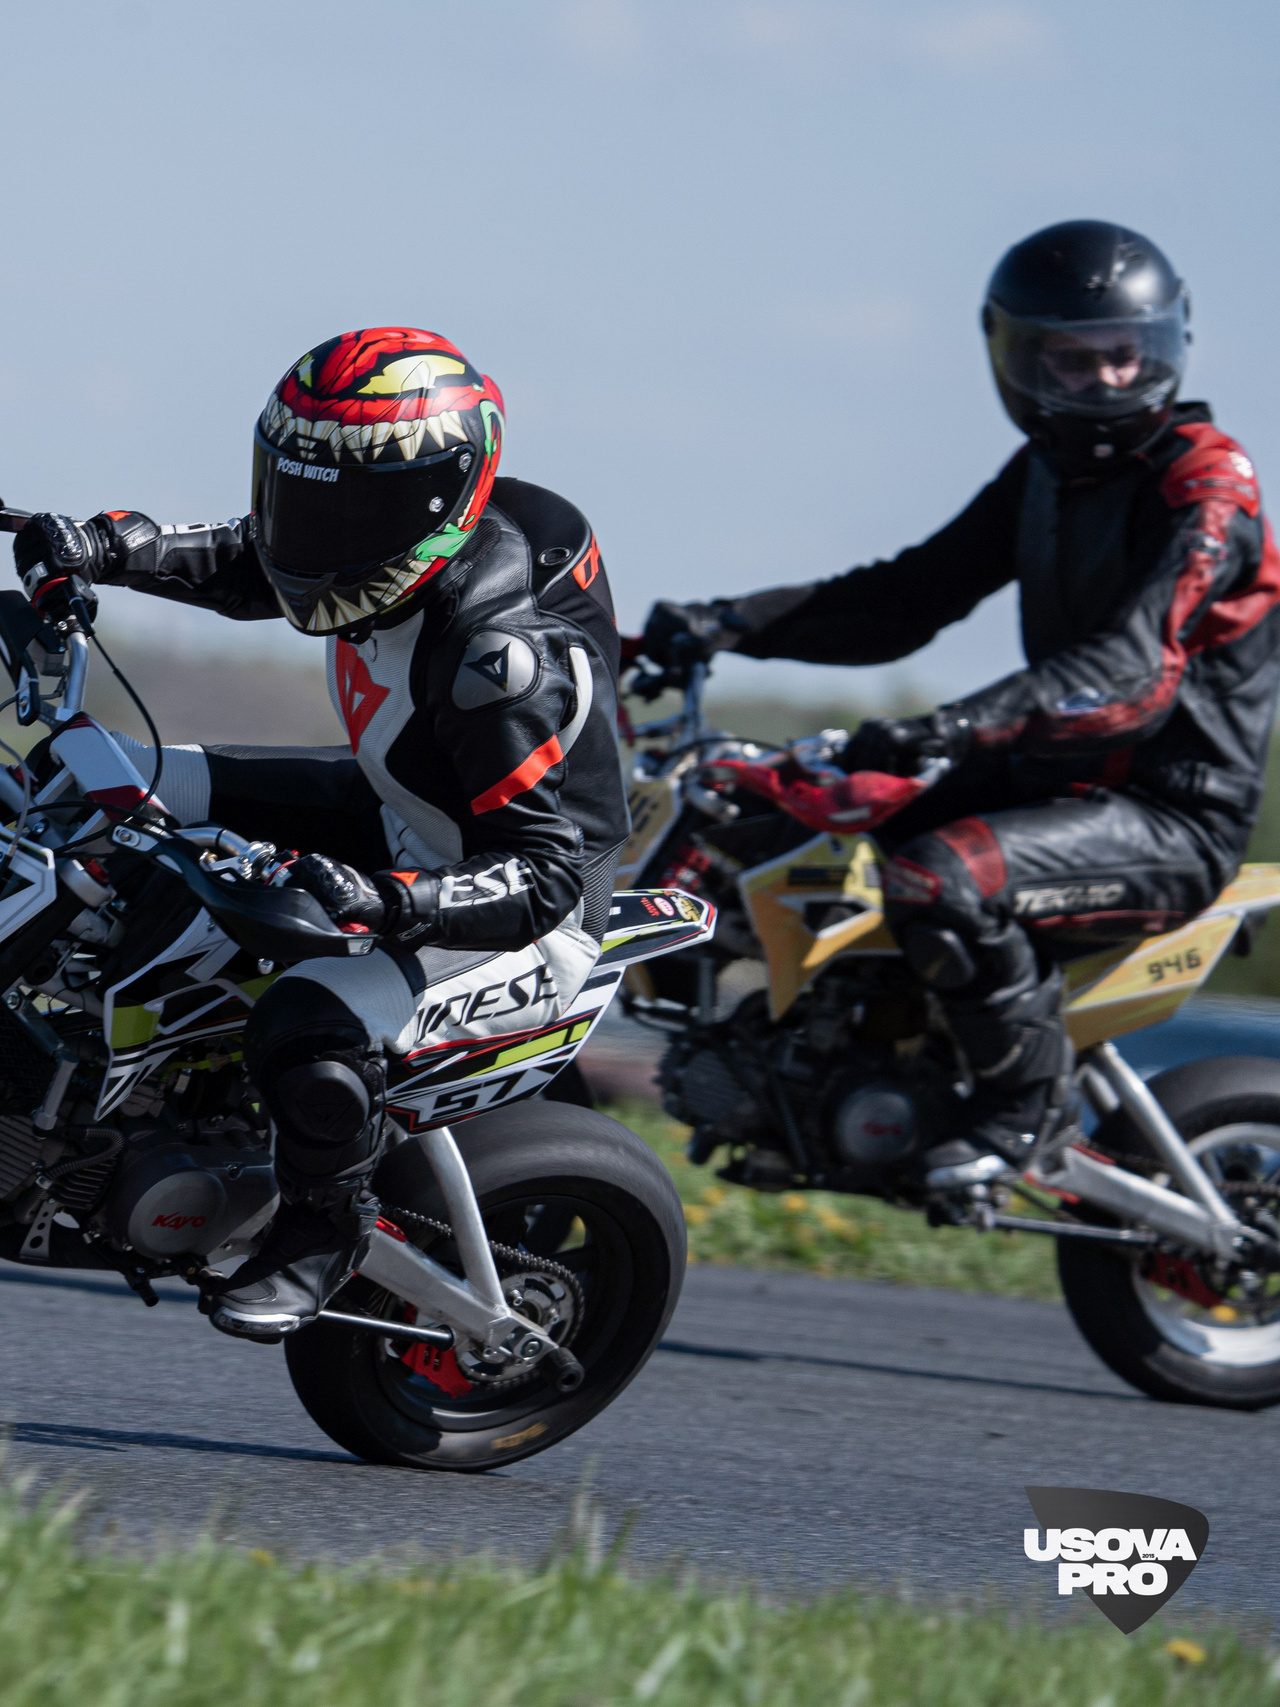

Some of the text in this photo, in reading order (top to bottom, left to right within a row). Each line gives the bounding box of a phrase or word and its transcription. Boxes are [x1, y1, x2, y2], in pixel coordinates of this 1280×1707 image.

[276, 457, 340, 483] POSH WITCH
[1148, 948, 1201, 984] 946
[416, 963, 559, 1043] INESE
[429, 1069, 529, 1120] 57
